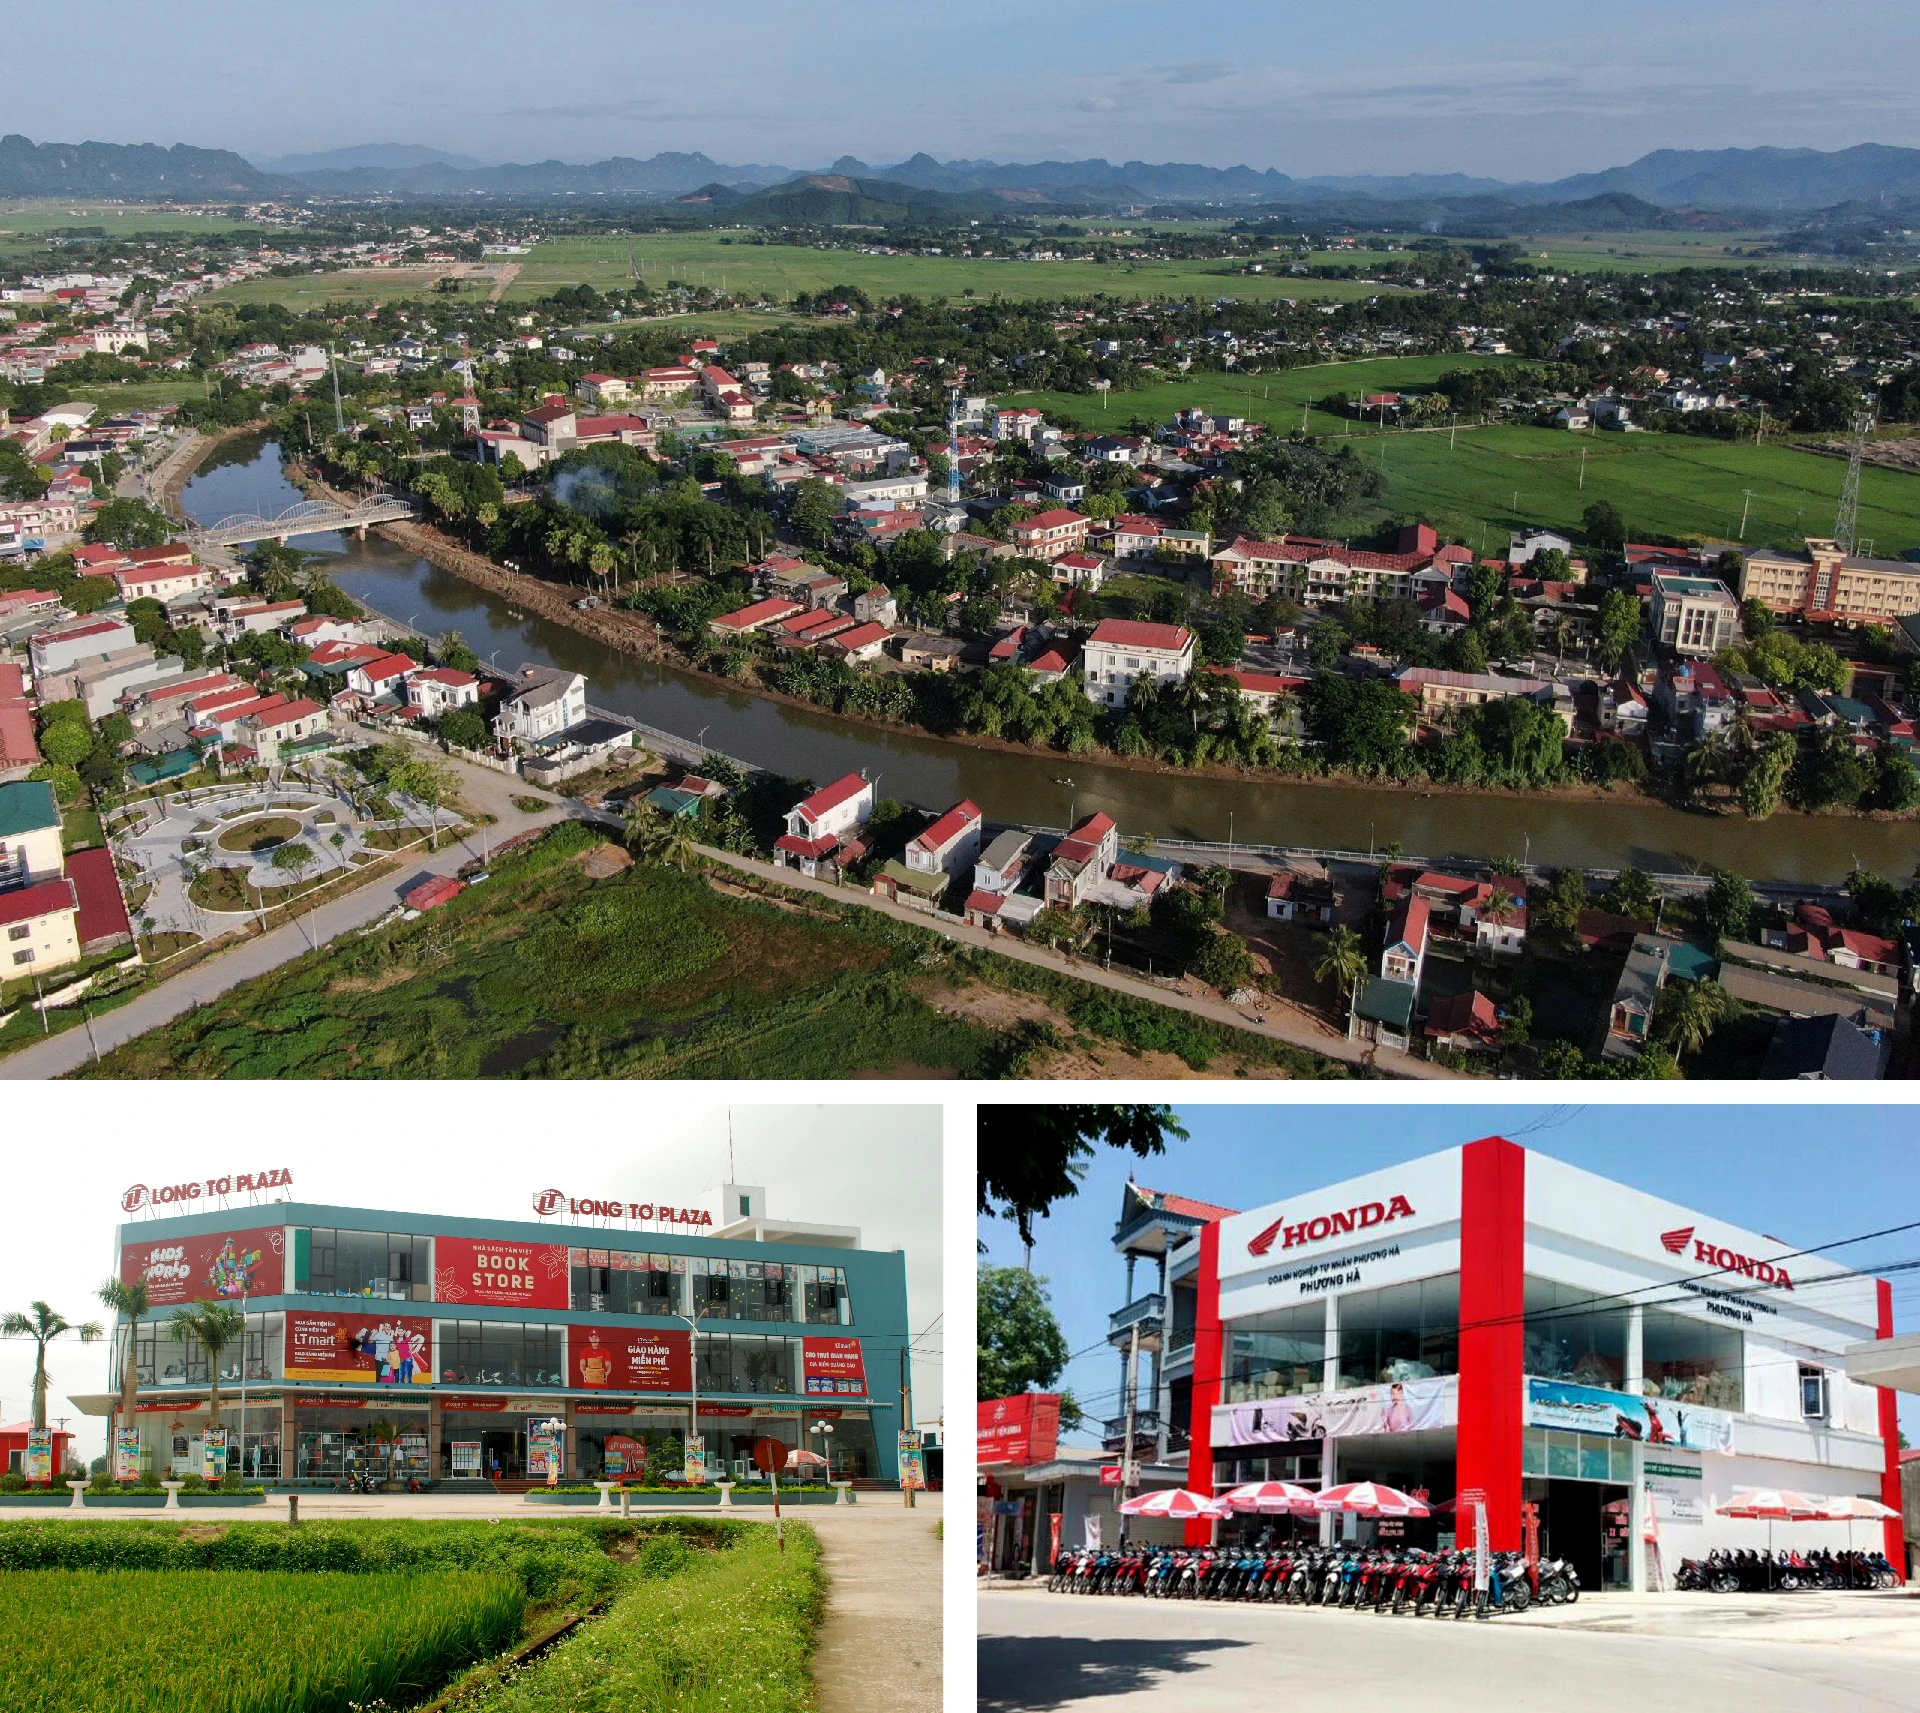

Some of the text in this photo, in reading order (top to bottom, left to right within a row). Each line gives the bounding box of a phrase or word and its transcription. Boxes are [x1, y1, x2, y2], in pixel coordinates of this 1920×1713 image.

[152, 1182, 201, 1205] LONG
[237, 1167, 293, 1192] PLAZA
[570, 1198, 623, 1218] LONG
[659, 1206, 713, 1226] PLAZA
[1282, 1194, 1416, 1248] HONDA
[150, 1246, 185, 1264] KIDS
[477, 1254, 530, 1272] BOOK
[1268, 1274, 1292, 1285] DOANH
[1331, 1258, 1352, 1270] NHÂN
[1353, 1249, 1388, 1264] PHƯƠNG
[1388, 1244, 1400, 1256] HÀ
[1694, 1239, 1795, 1291] HONDA
[144, 1261, 191, 1281] WORLD
[472, 1272, 534, 1289] STORE
[1300, 1267, 1361, 1293] PHƯƠNG HÀ
[1706, 1301, 1753, 1323] PHƯƠNG HÀ
[628, 1344, 670, 1355] GIAO HÀNG
